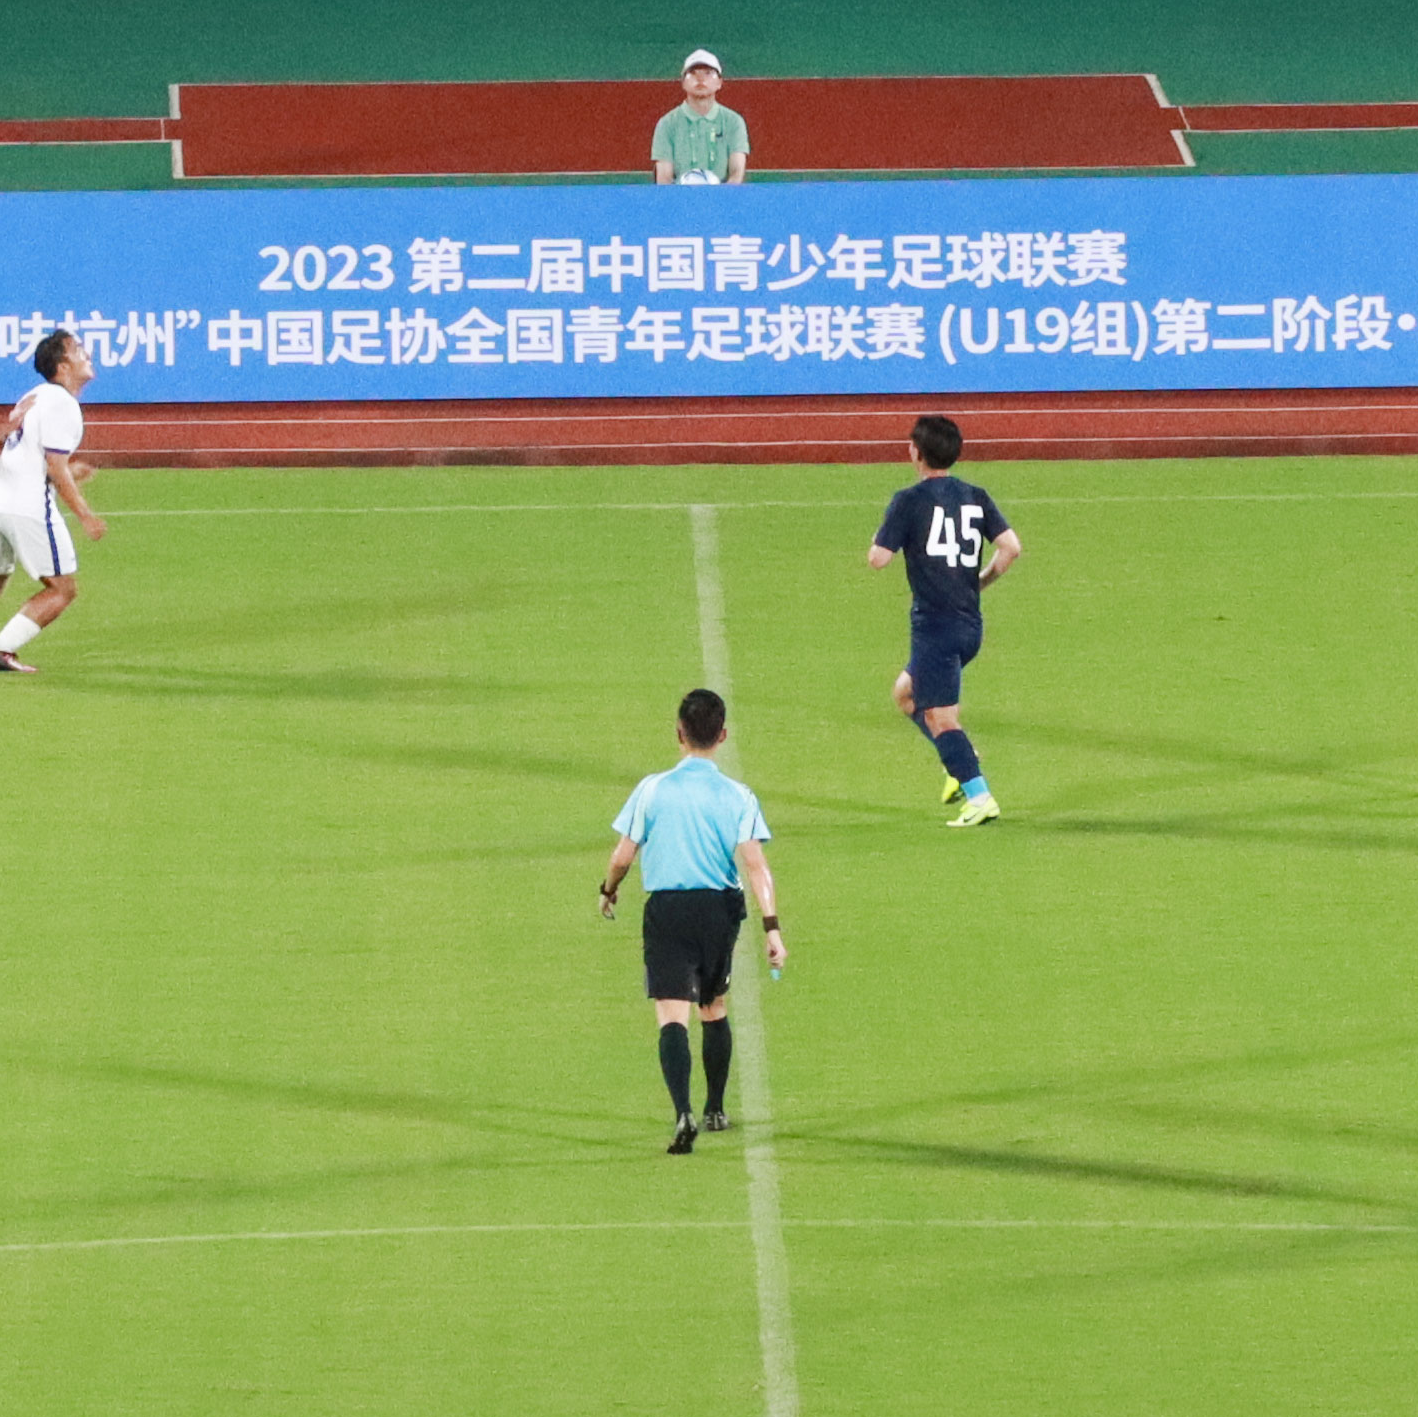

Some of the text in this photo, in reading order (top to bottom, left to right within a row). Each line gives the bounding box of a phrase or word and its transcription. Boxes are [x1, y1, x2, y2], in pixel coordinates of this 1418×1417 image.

[260, 230, 1128, 292] 2023 第二届中国青少年足球联赛
[925, 504, 984, 568] 45
